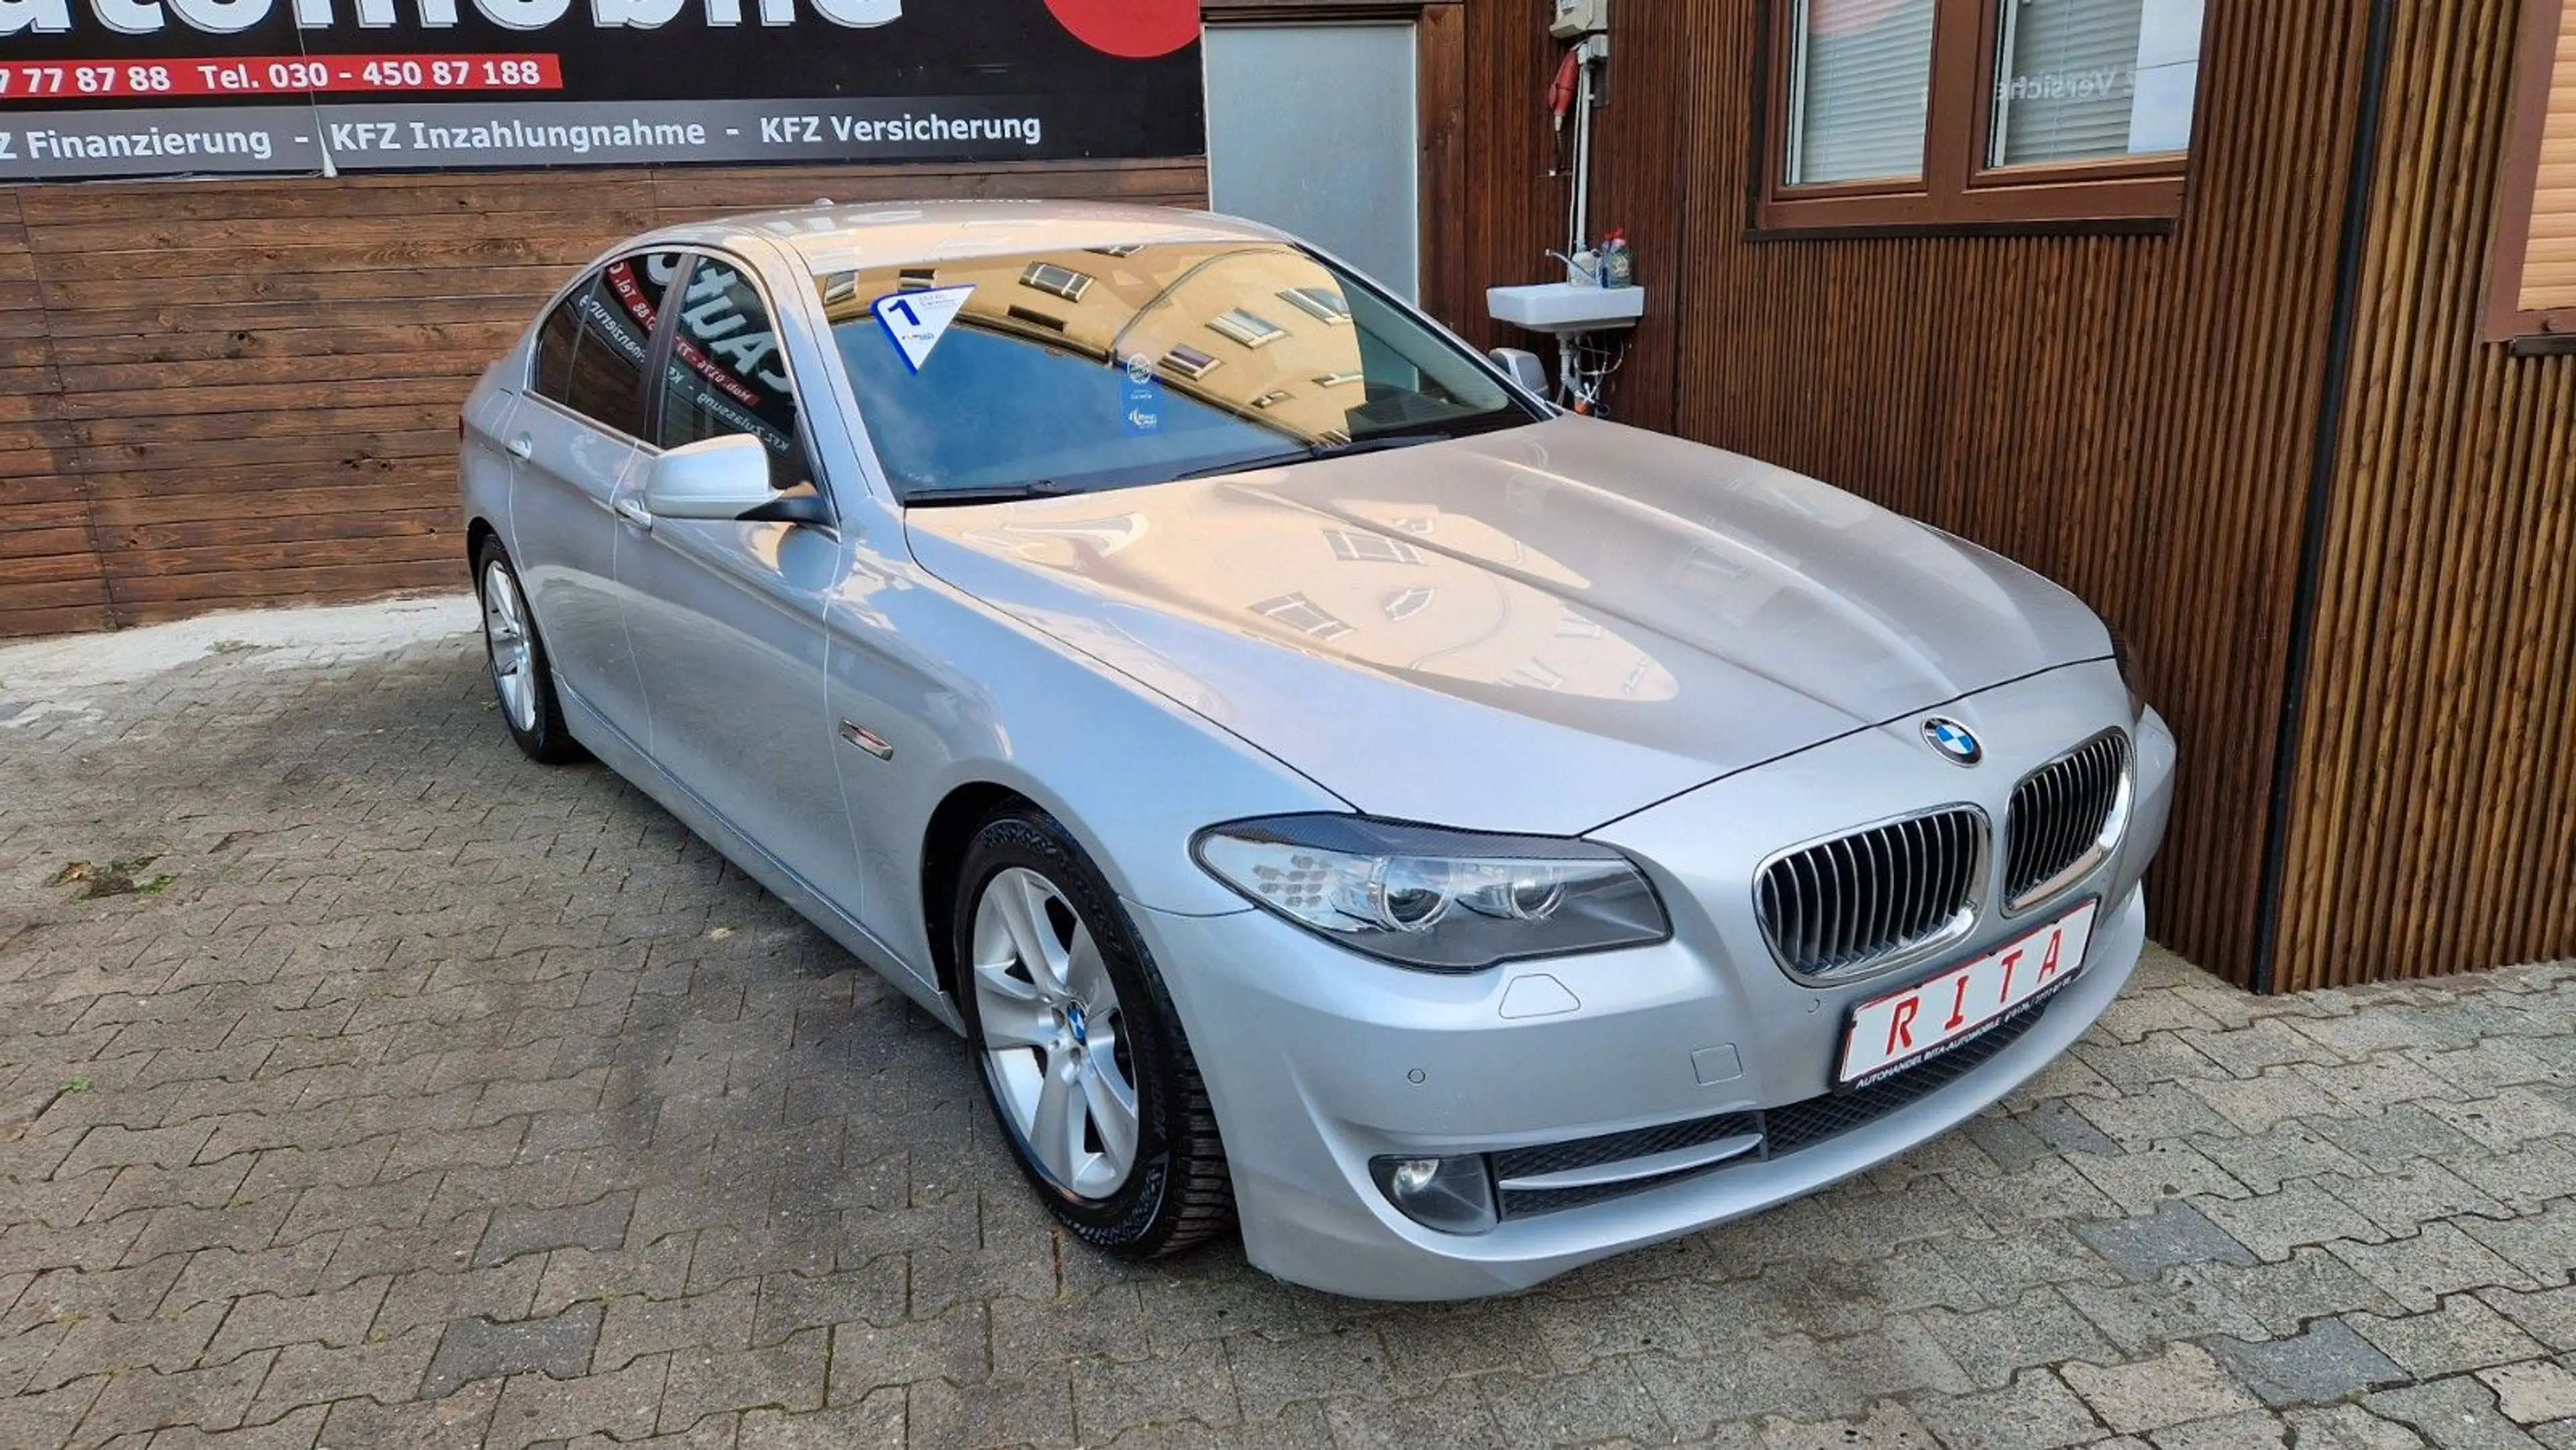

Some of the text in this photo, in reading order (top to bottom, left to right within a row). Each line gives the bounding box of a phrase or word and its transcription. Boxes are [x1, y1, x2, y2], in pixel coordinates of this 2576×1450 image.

[22, 68, 62, 93] 77
[75, 67, 115, 92] 87
[127, 66, 170, 91] 88
[198, 64, 259, 89] Tel.
[269, 62, 327, 88] 030
[363, 61, 421, 86] 450
[432, 61, 468, 85] 87
[482, 60, 540, 85] 188
[25, 126, 272, 160] Finanzierung
[330, 123, 401, 150] KFZ
[409, 119, 705, 153] Inzahlungnahme
[760, 116, 822, 143] KFZ
[830, 114, 1041, 145] Versicherung
[888, 298, 921, 327] 1
[1854, 1054, 1923, 1090] AUTOHANDEL
